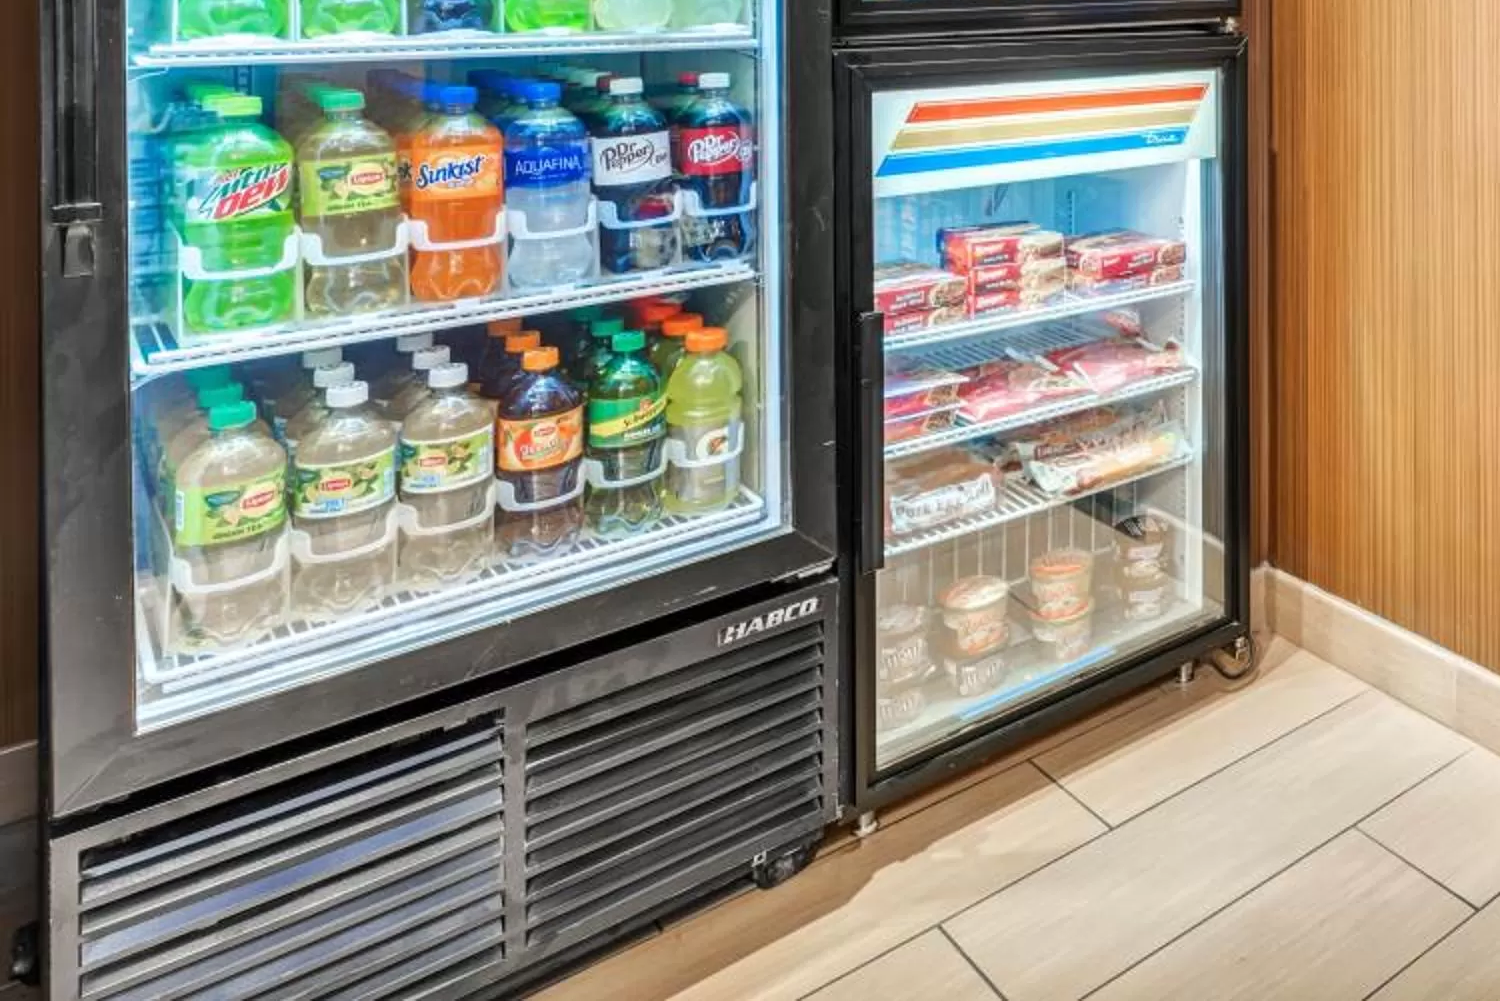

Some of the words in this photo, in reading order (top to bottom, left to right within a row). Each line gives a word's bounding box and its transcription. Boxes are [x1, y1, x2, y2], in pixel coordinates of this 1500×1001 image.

[416, 155, 486, 188] Sunkist
[515, 155, 582, 176] AQUAFINA
[721, 597, 819, 645] HABCO
